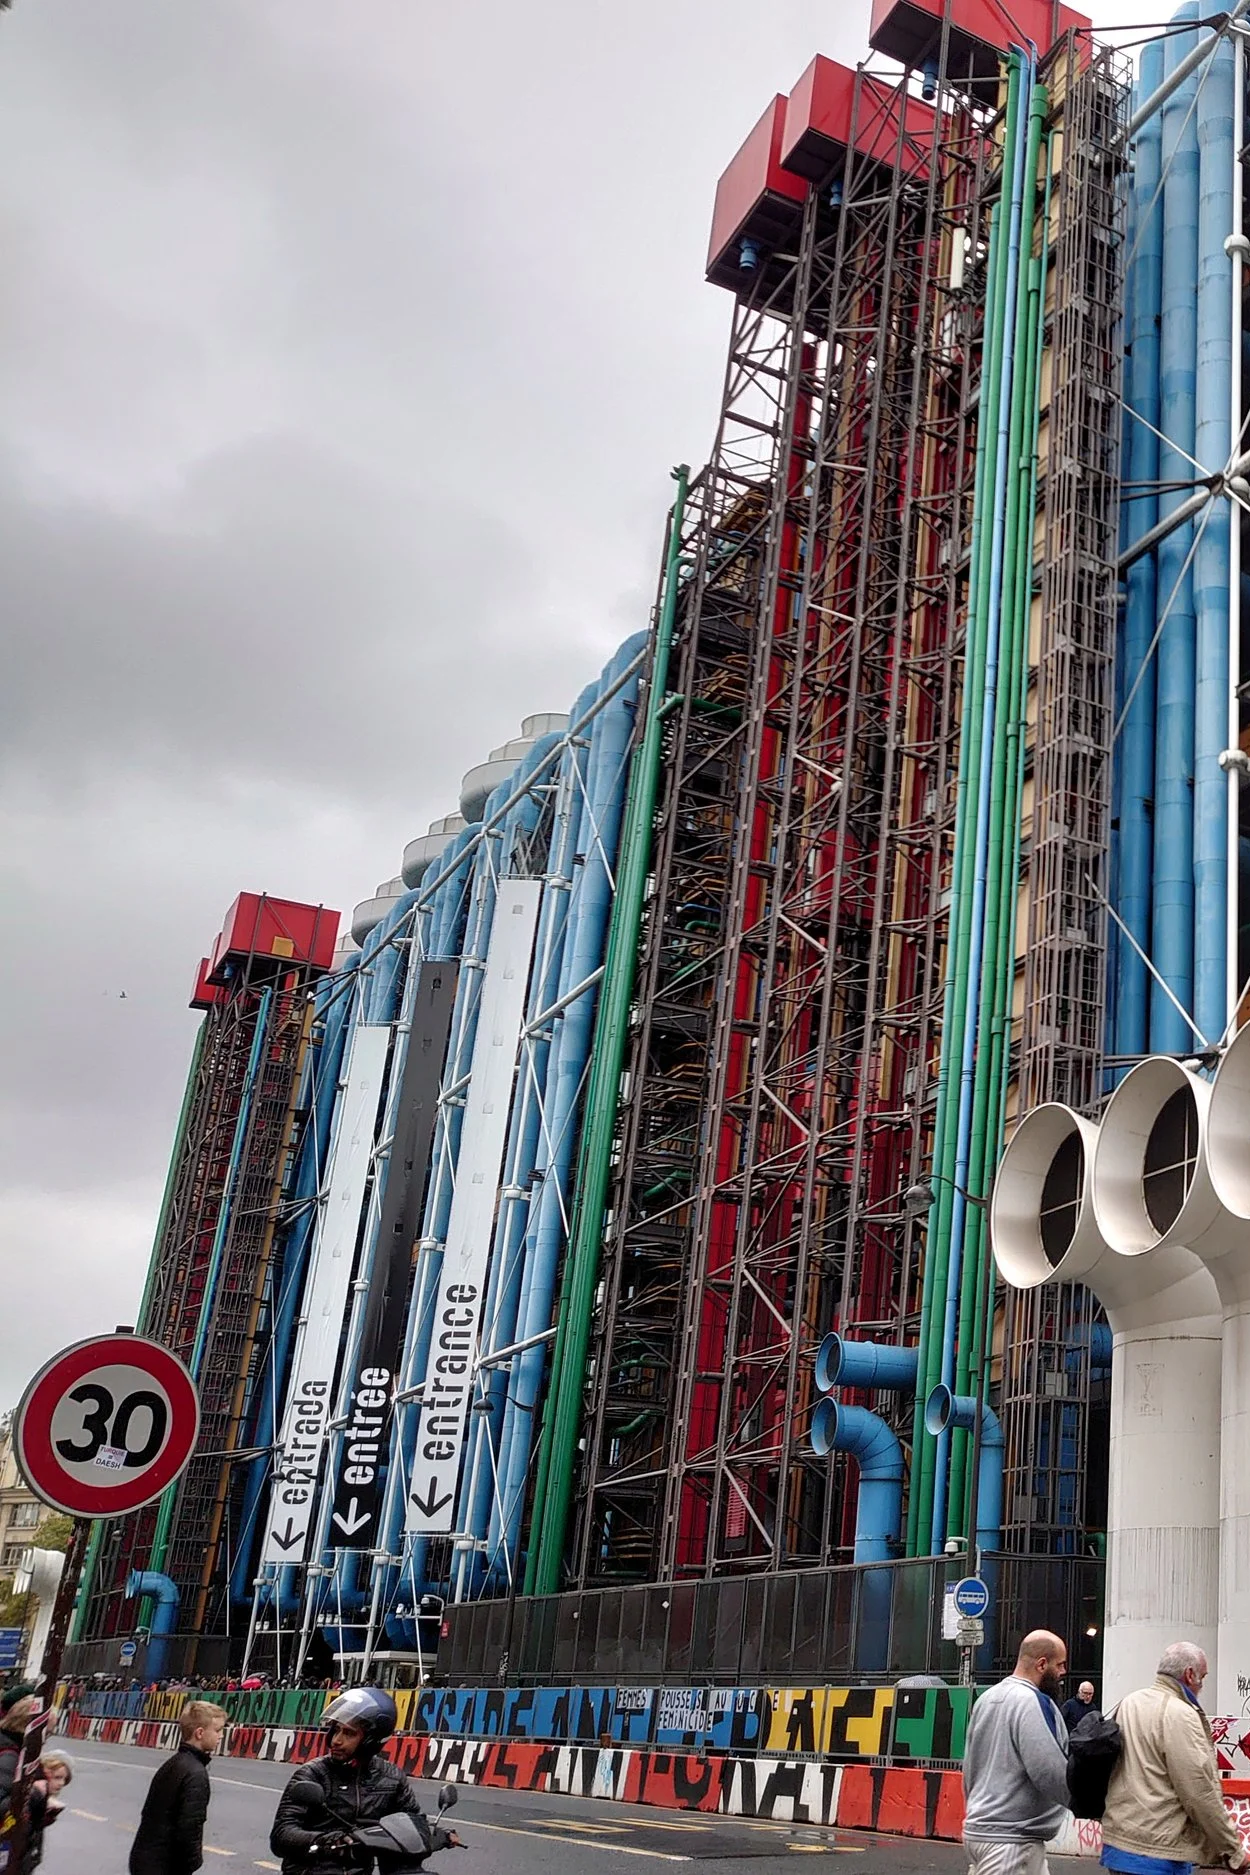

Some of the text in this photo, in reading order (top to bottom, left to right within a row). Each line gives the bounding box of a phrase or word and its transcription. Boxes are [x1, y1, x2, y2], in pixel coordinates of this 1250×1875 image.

[422, 1284, 478, 1461] entrance
[56, 1383, 168, 1468] 30
[95, 1457, 121, 1470] DAESH
[282, 1380, 328, 1505] entrada
[343, 1367, 390, 1485] entrée
[617, 1687, 647, 1709] FEMMES
